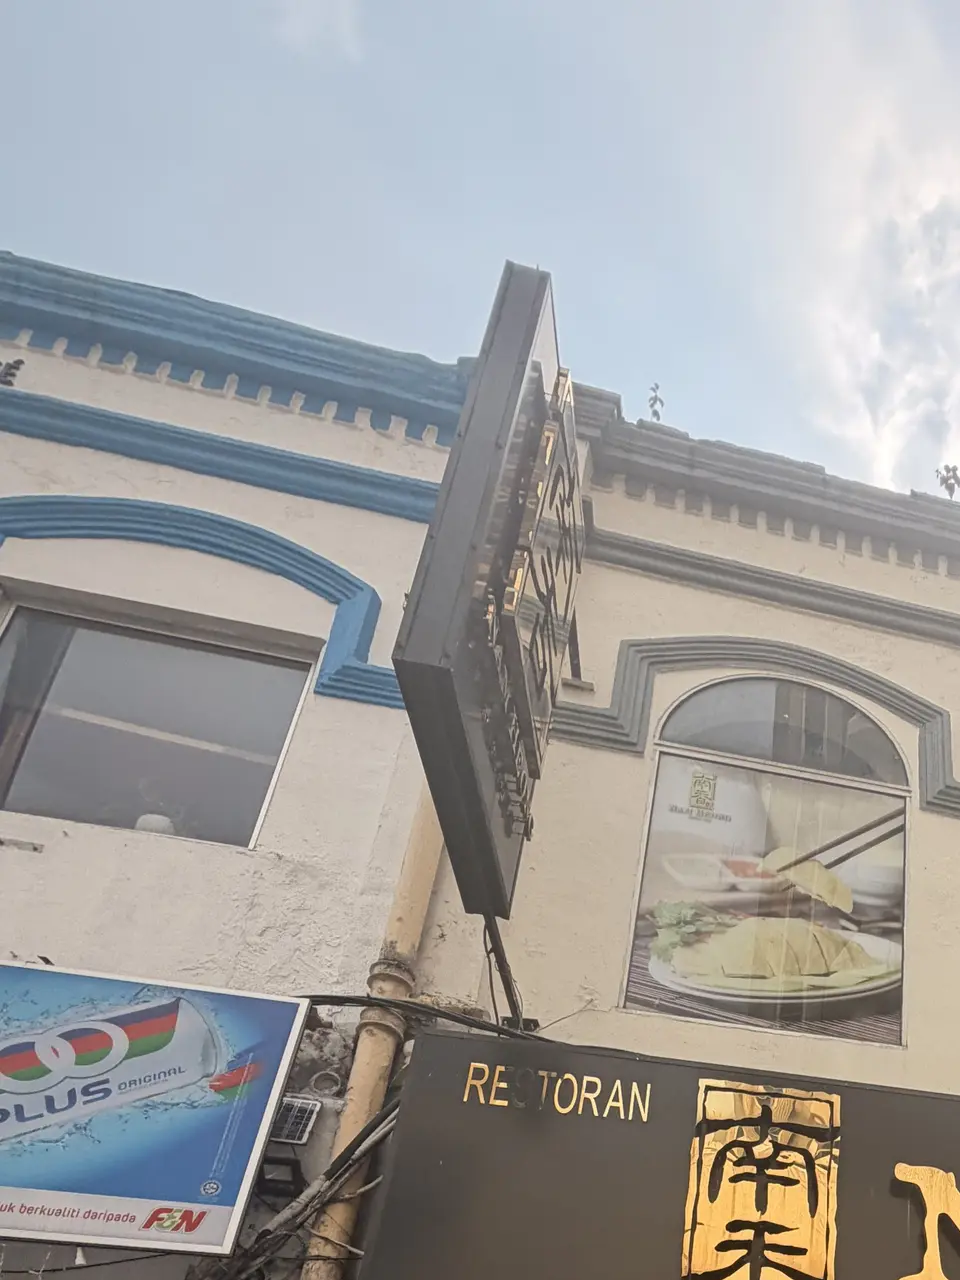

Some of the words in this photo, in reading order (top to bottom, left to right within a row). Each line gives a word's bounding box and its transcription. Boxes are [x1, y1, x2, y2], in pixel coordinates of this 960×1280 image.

[117, 1066, 187, 1092] ORIGINAL
[19, 1204, 80, 1218] berkualiti
[83, 1209, 136, 1224] daripada
[142, 1207, 207, 1233] F&N
